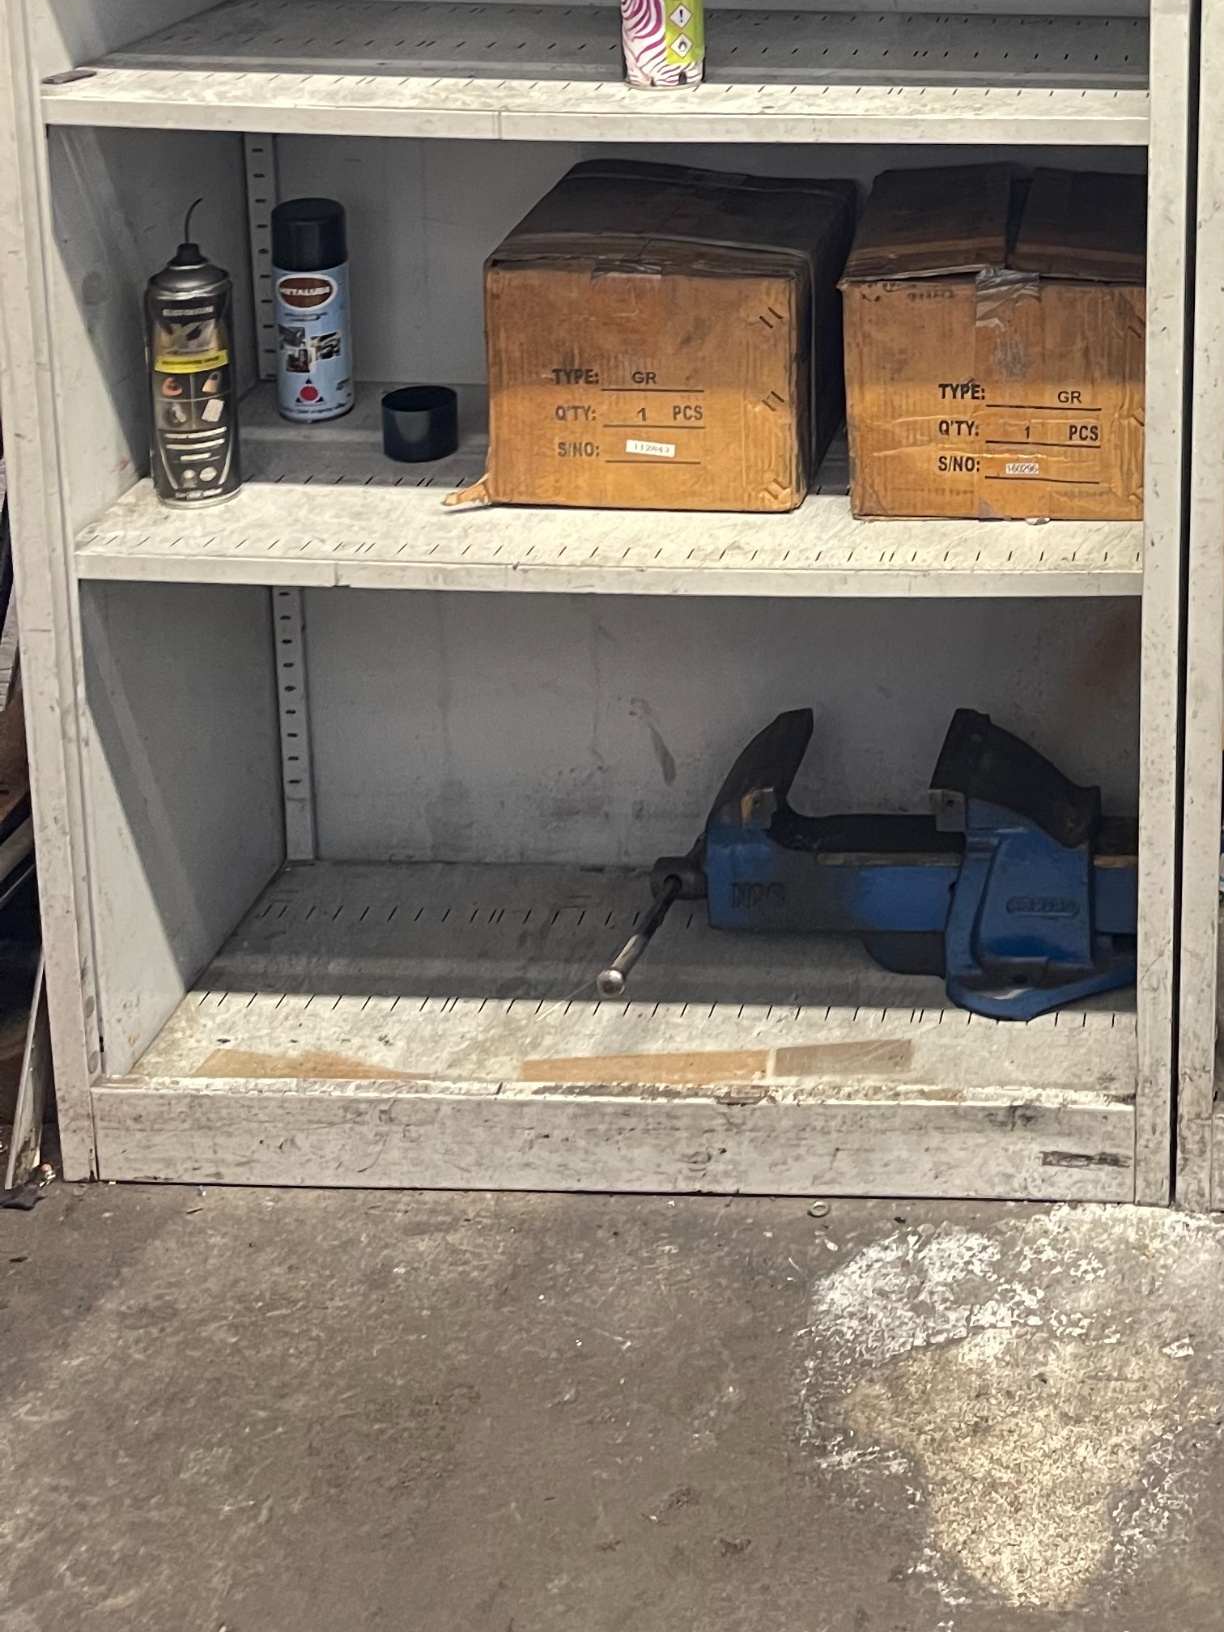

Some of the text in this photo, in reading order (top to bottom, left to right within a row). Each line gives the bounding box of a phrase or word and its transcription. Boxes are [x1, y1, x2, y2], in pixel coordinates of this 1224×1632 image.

[552, 368, 657, 384] TYPE: GR
[939, 384, 1082, 403] TYPE: GR
[555, 406, 597, 421] Q'TY:
[673, 405, 703, 421] PCS
[939, 420, 1099, 441] Q'TY: 1 PCS
[558, 441, 600, 457] S/NO:
[938, 456, 980, 472] S/NO:
